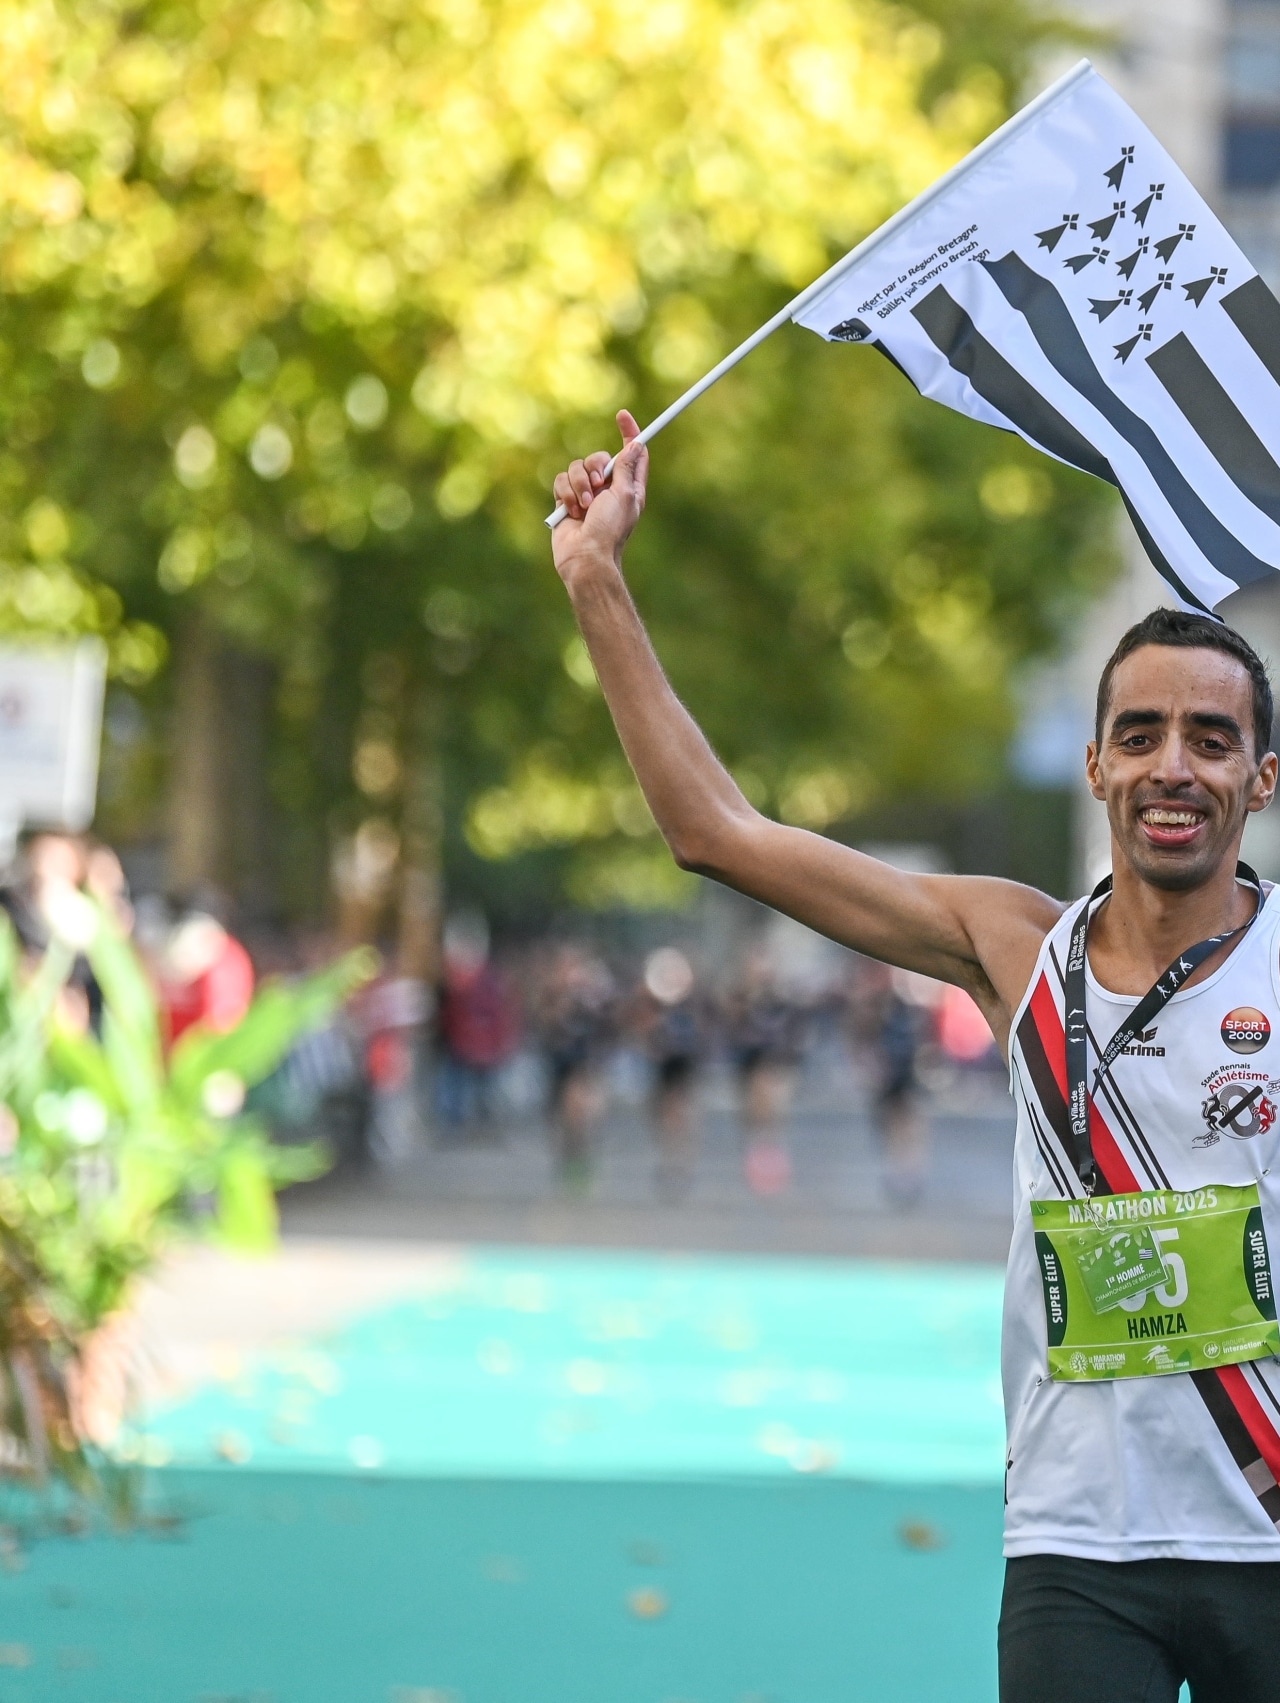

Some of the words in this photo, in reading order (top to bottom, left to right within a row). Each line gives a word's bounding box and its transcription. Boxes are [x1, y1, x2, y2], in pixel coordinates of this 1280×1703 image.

[948, 240, 979, 263] Breizh
[857, 292, 884, 313] Offert
[882, 281, 898, 297] par
[897, 273, 908, 284] la
[907, 253, 938, 276] Région
[937, 224, 979, 255] Bretagne
[1072, 934, 1079, 945] de
[1070, 944, 1079, 961] Ville
[1225, 1020, 1267, 1031] SPORT
[1228, 1030, 1263, 1041] 2000
[1114, 1031, 1124, 1043] de
[1119, 1044, 1166, 1057] erima
[1200, 1069, 1220, 1088] Stade
[1219, 1062, 1251, 1073] Rennais
[1208, 1070, 1270, 1094] Athlétisme
[1070, 1090, 1078, 1102] de
[1071, 1102, 1079, 1121] Ville
[1068, 1196, 1167, 1224] MARATHON
[1173, 1188, 1218, 1214] 2025
[1248, 1230, 1266, 1269] SUPER
[1043, 1253, 1058, 1282] ÉLITE
[1116, 1263, 1145, 1284] HOMME
[1132, 1279, 1139, 1287] DE
[1138, 1267, 1162, 1284] BRETAGNE
[1254, 1272, 1271, 1301] ÉLITE
[1049, 1286, 1063, 1324] SUPER
[1126, 1312, 1188, 1340] HAMZA
[1092, 1362, 1106, 1371] VERT
[1093, 1353, 1126, 1364] MARATHON
